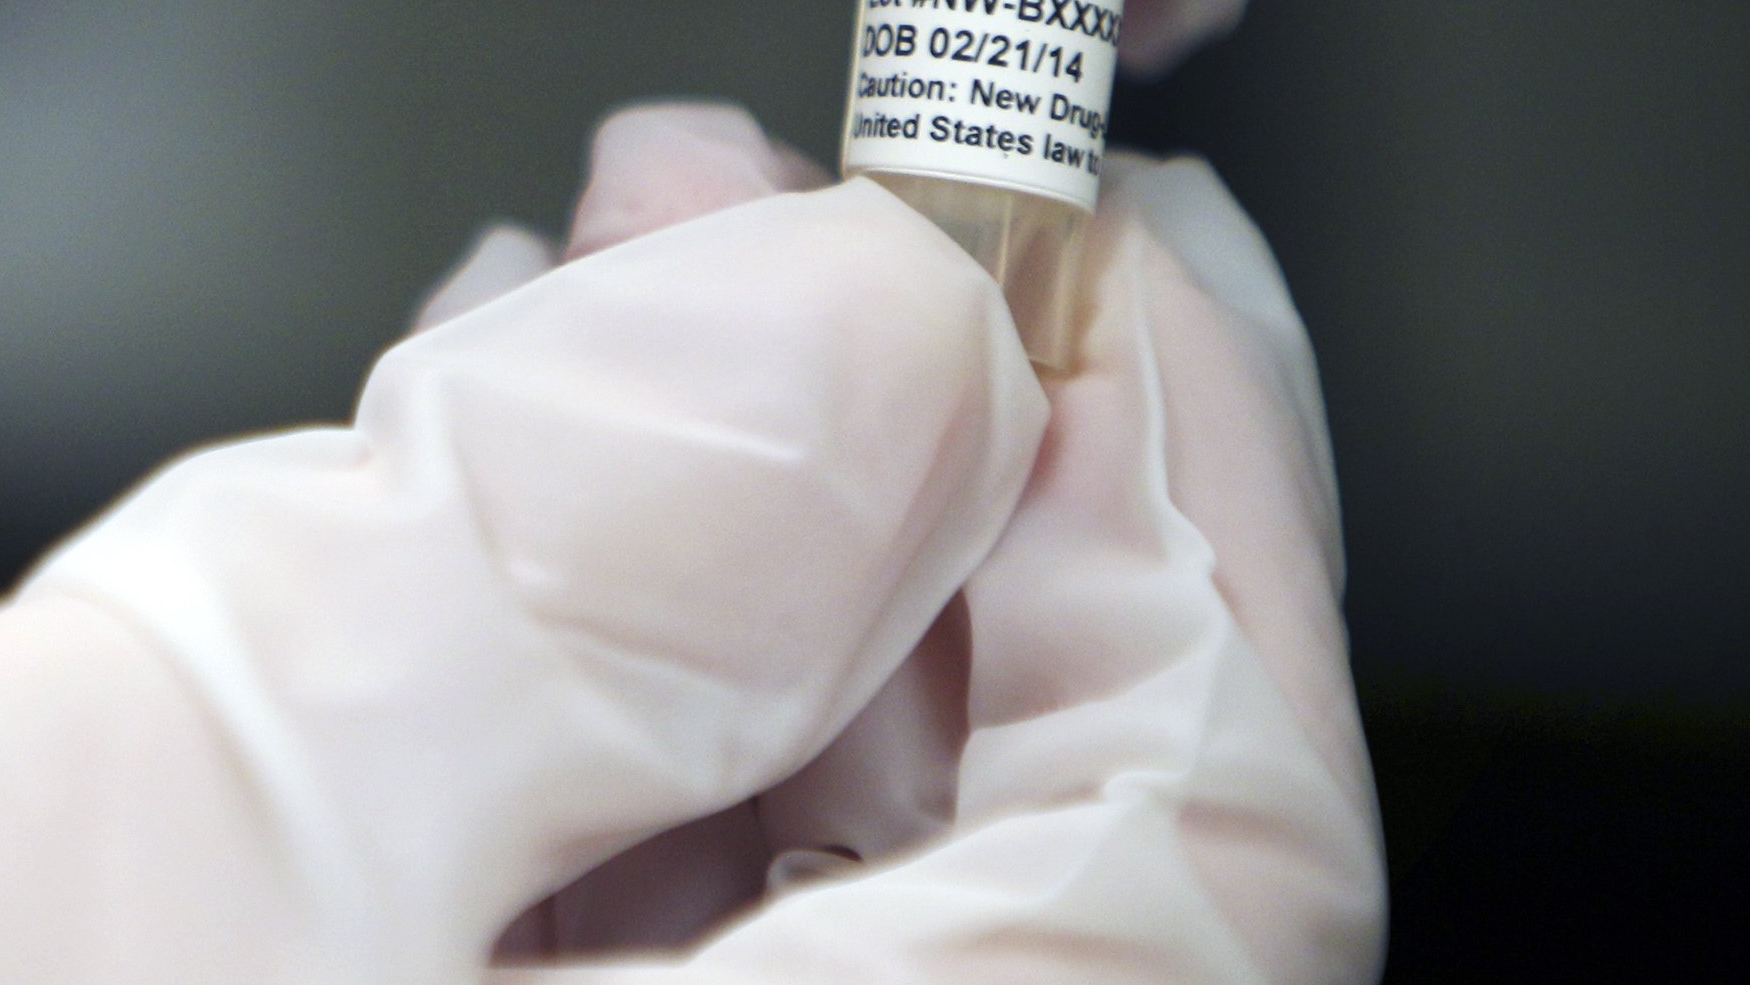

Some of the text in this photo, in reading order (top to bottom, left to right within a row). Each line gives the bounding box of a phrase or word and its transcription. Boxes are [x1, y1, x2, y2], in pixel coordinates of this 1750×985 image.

[864, 24, 1084, 83] DOB 02/21/14
[858, 72, 958, 102] Caution:
[970, 79, 1041, 115] New
[853, 112, 920, 139] United
[930, 116, 1034, 155] States
[1043, 134, 1085, 168] law
